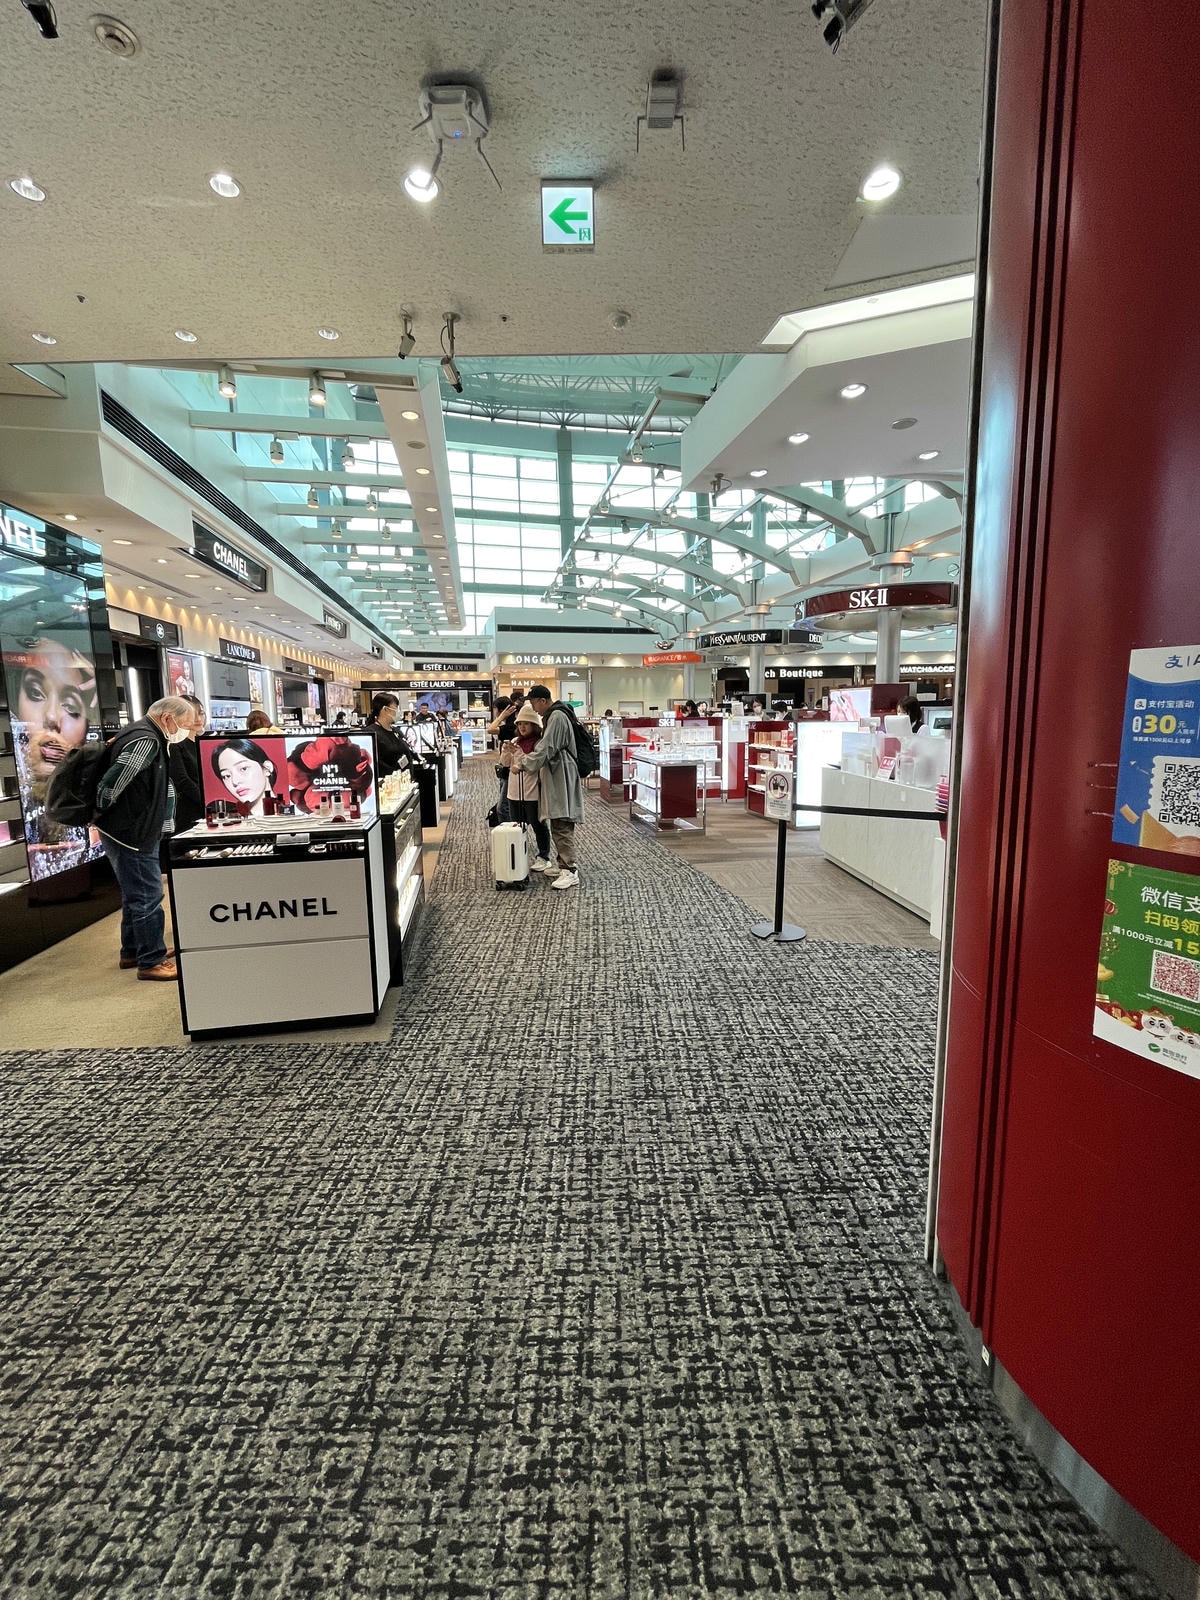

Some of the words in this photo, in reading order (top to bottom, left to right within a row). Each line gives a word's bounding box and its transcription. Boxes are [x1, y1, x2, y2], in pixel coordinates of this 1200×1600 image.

[212, 541, 250, 577] CHANEL
[848, 588, 888, 608] SK-II
[510, 655, 579, 664] LONGCHAMP
[423, 663, 443, 671] ESTÉE
[780, 669, 824, 679] Boutique
[409, 680, 428, 688] ESTÉE
[429, 680, 456, 688] LAUDER
[1143, 715, 1176, 734] 30
[313, 778, 350, 786] CHANEL
[209, 897, 338, 923] CHANEL
[1144, 910, 1200, 936] 扫码领
